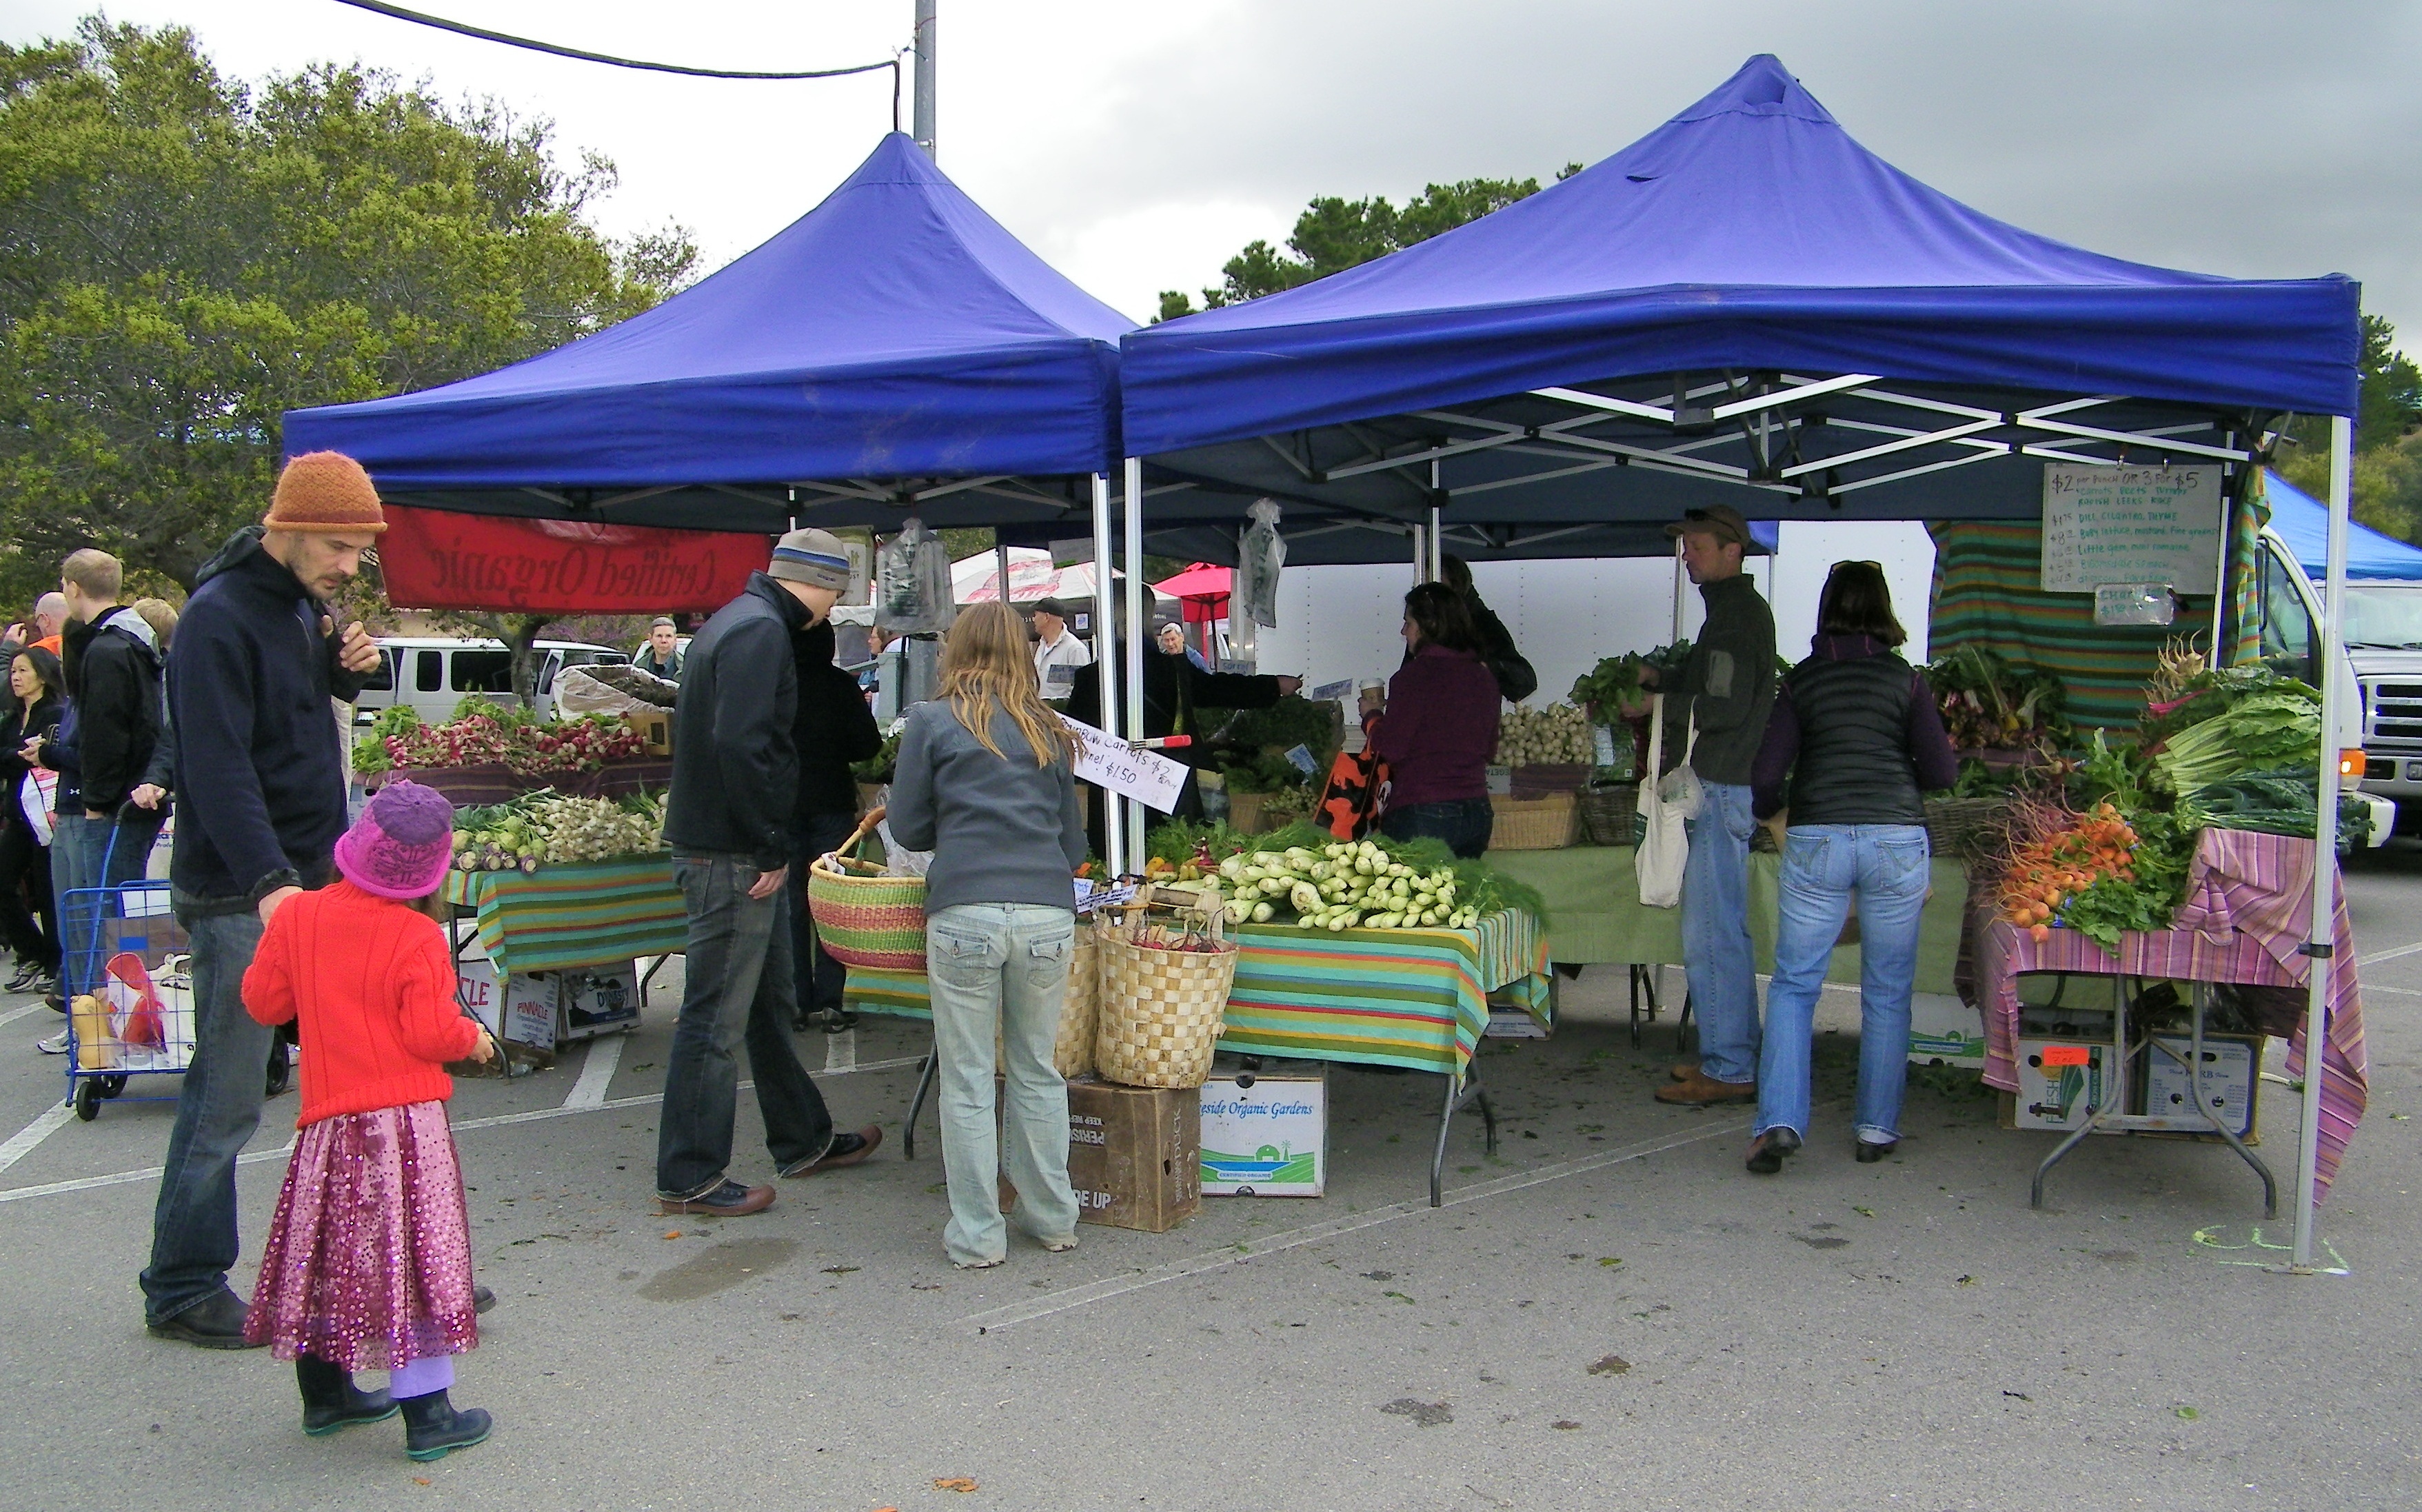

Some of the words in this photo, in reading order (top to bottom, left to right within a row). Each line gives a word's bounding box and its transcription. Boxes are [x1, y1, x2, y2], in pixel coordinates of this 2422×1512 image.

[2052, 474, 2074, 494] $2
[2142, 470, 2152, 485] 3
[2175, 473, 2199, 490] $5
[1200, 1100, 1227, 1116] eside
[1229, 1102, 1269, 1119] Organic
[1271, 1100, 1313, 1119] Gardens
[1093, 1191, 1111, 1209] UP
